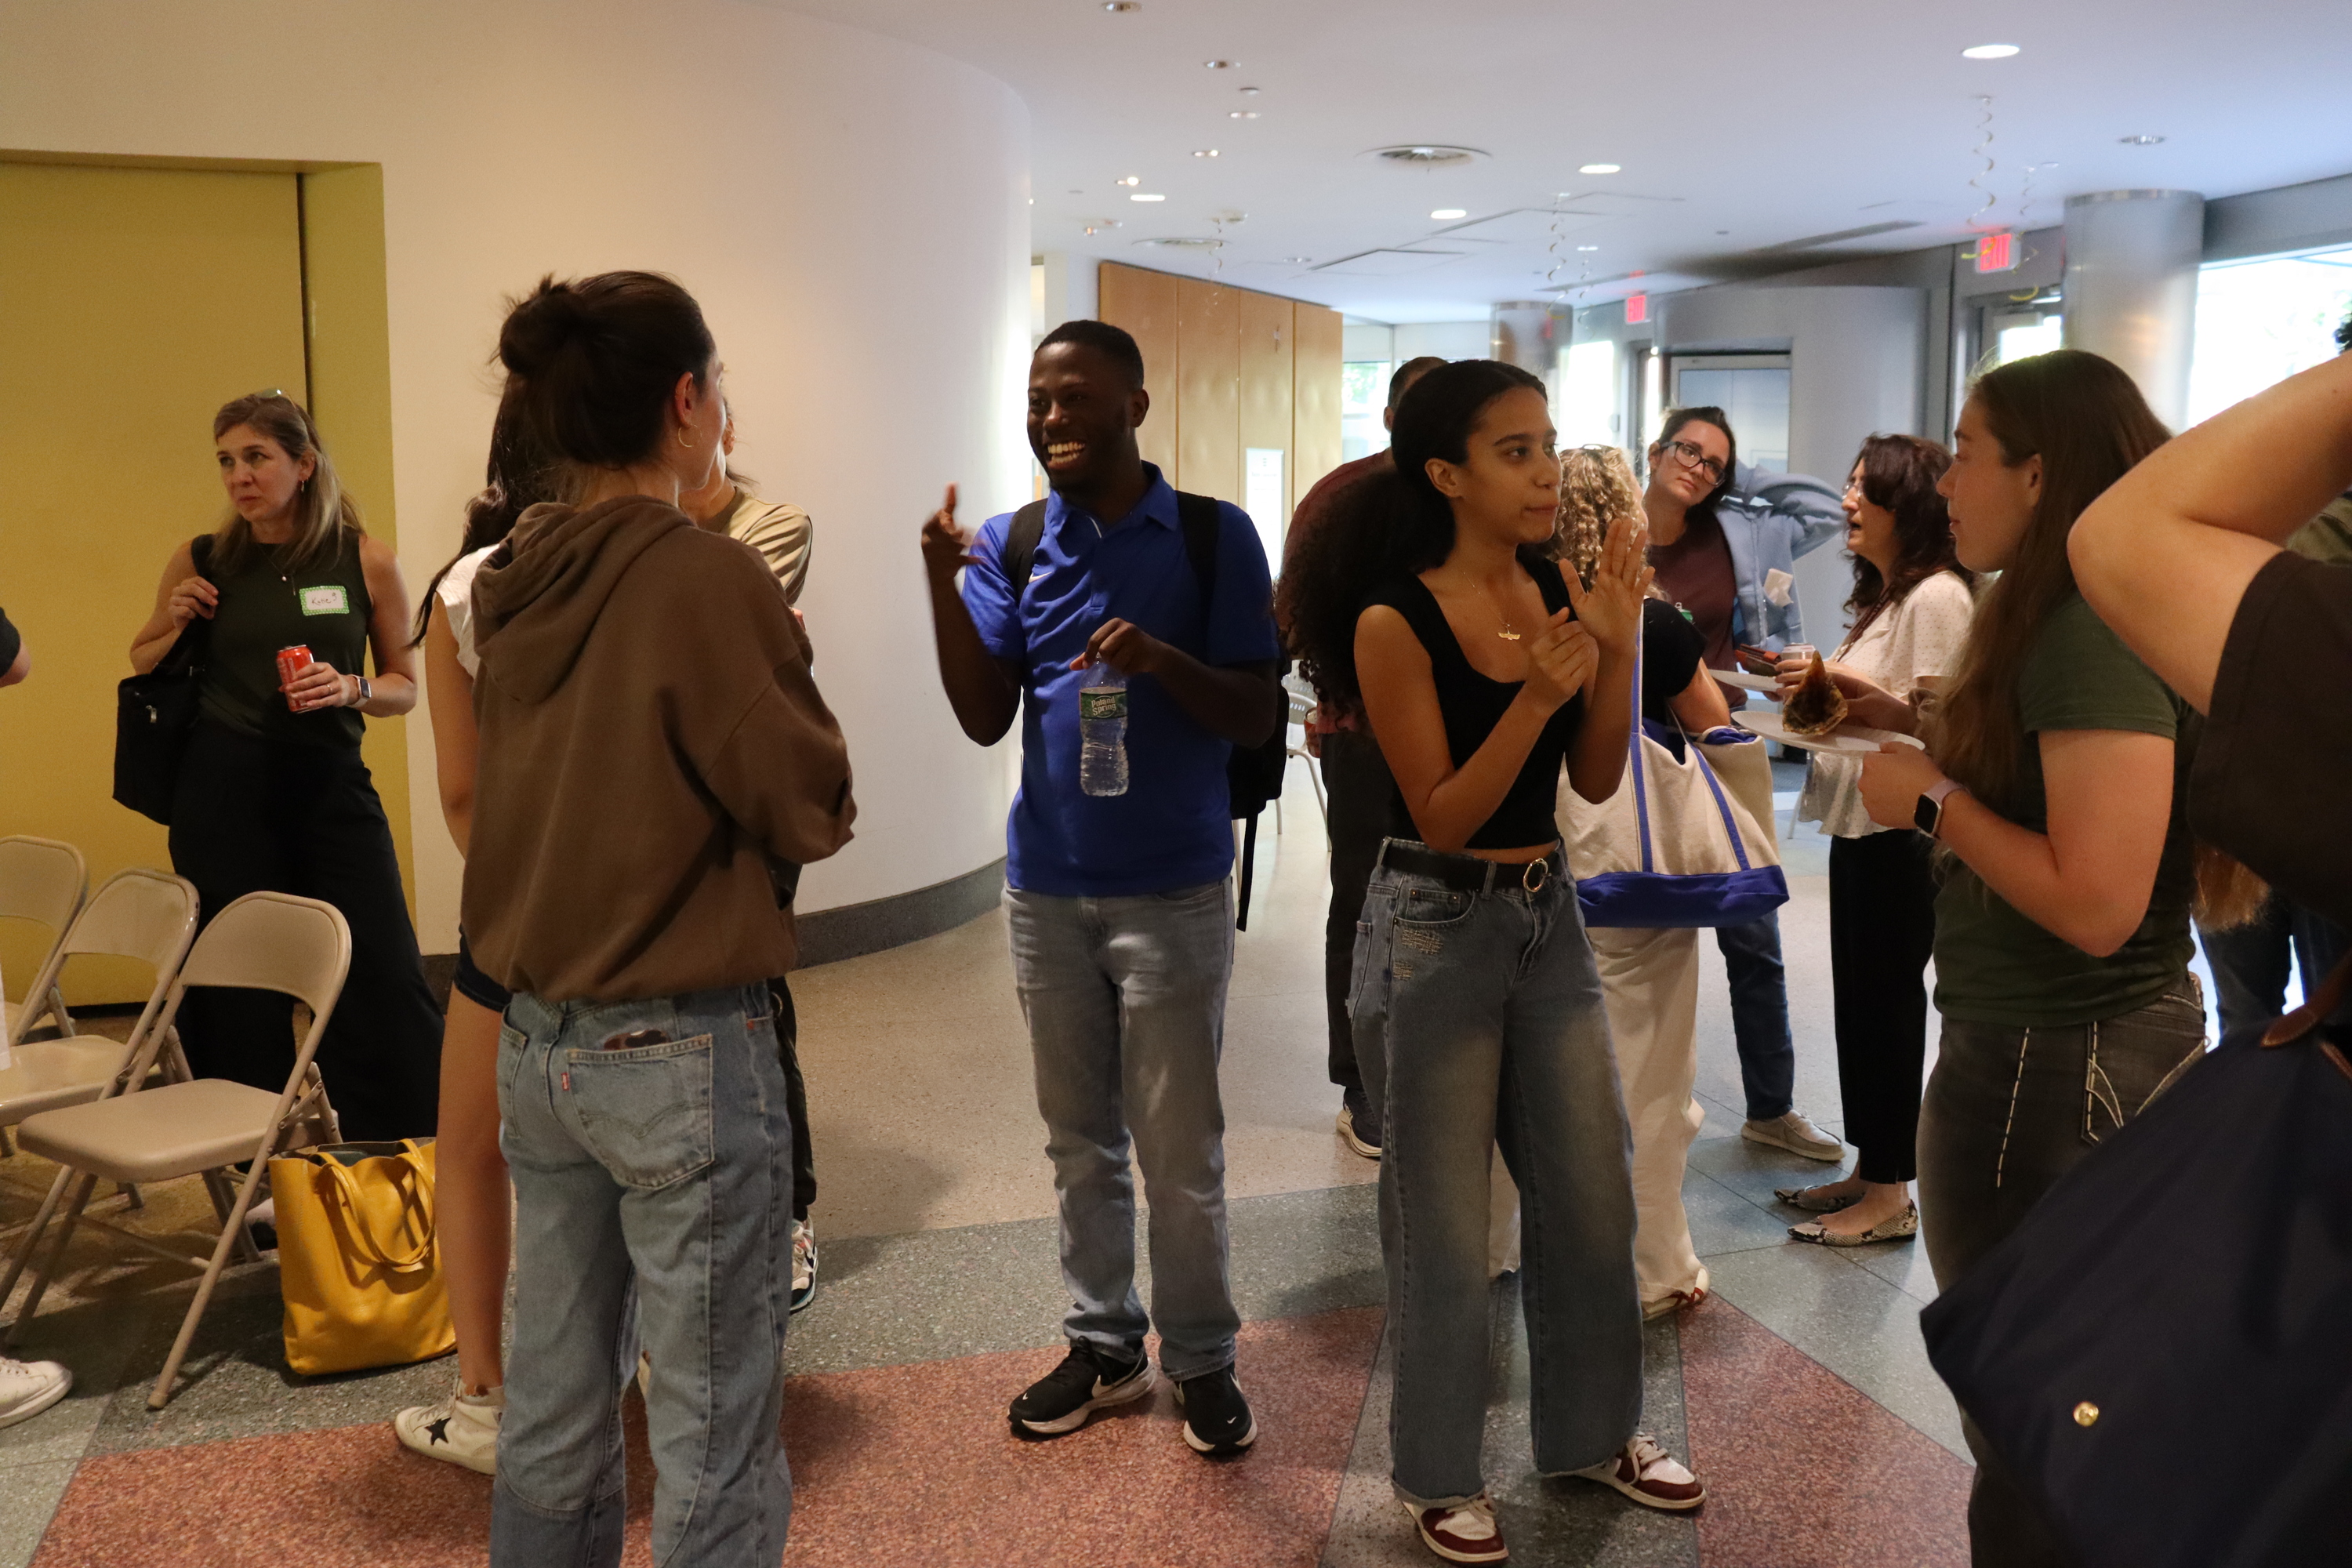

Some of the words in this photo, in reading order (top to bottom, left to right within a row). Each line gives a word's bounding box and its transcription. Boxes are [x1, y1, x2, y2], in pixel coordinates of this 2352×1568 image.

[1980, 234, 2012, 270] EXIT
[1091, 696, 1116, 708] Poland
[1092, 703, 1116, 716] Spring
